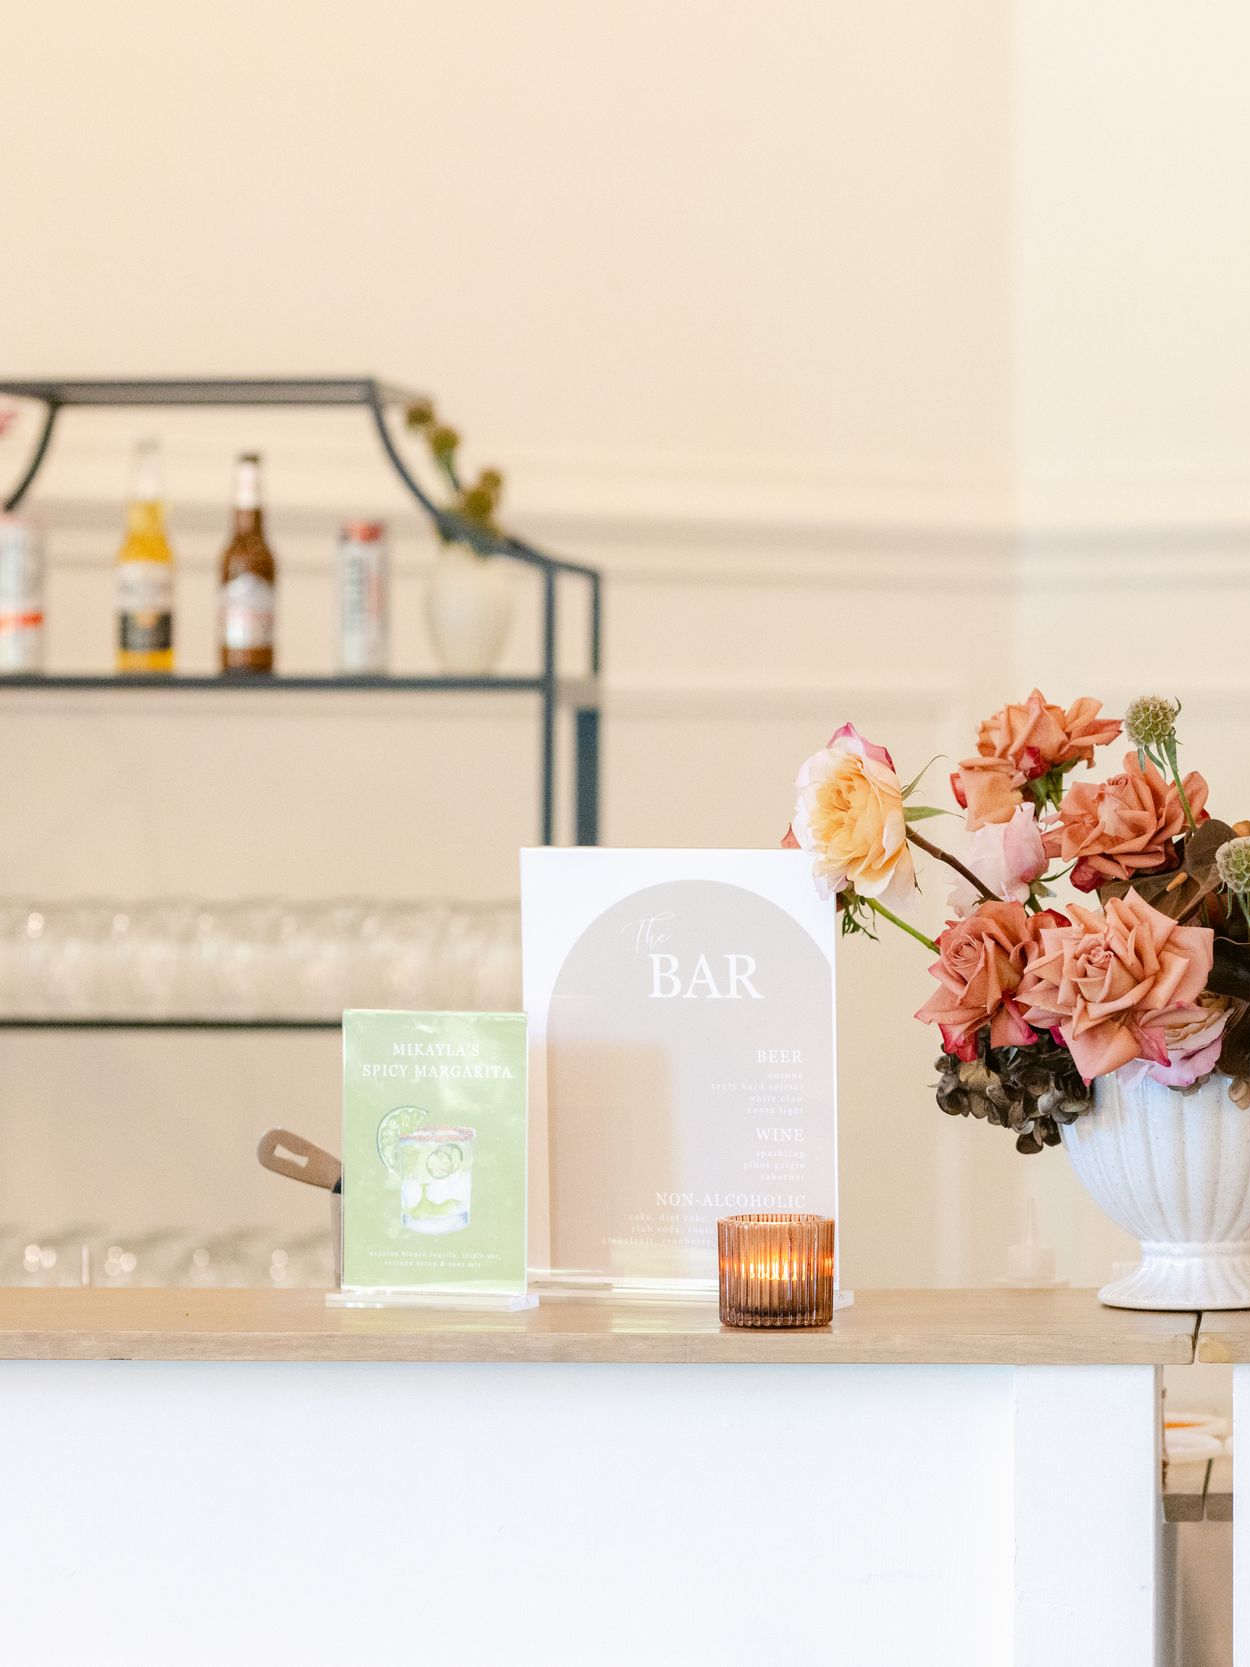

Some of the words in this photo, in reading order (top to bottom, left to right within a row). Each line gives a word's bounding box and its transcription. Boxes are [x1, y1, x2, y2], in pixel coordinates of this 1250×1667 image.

[621, 911, 674, 955] The
[648, 952, 765, 999] BAR
[392, 1043, 480, 1057] MIKAYLA'S
[757, 1049, 804, 1064] BEER
[362, 1064, 409, 1078] SPICY
[414, 1064, 512, 1079] MARGARITA
[711, 1080, 737, 1092] truly
[755, 1128, 805, 1142] WINE
[743, 1160, 770, 1171] pinot
[656, 1192, 807, 1209] NON-ALCOHOLIC
